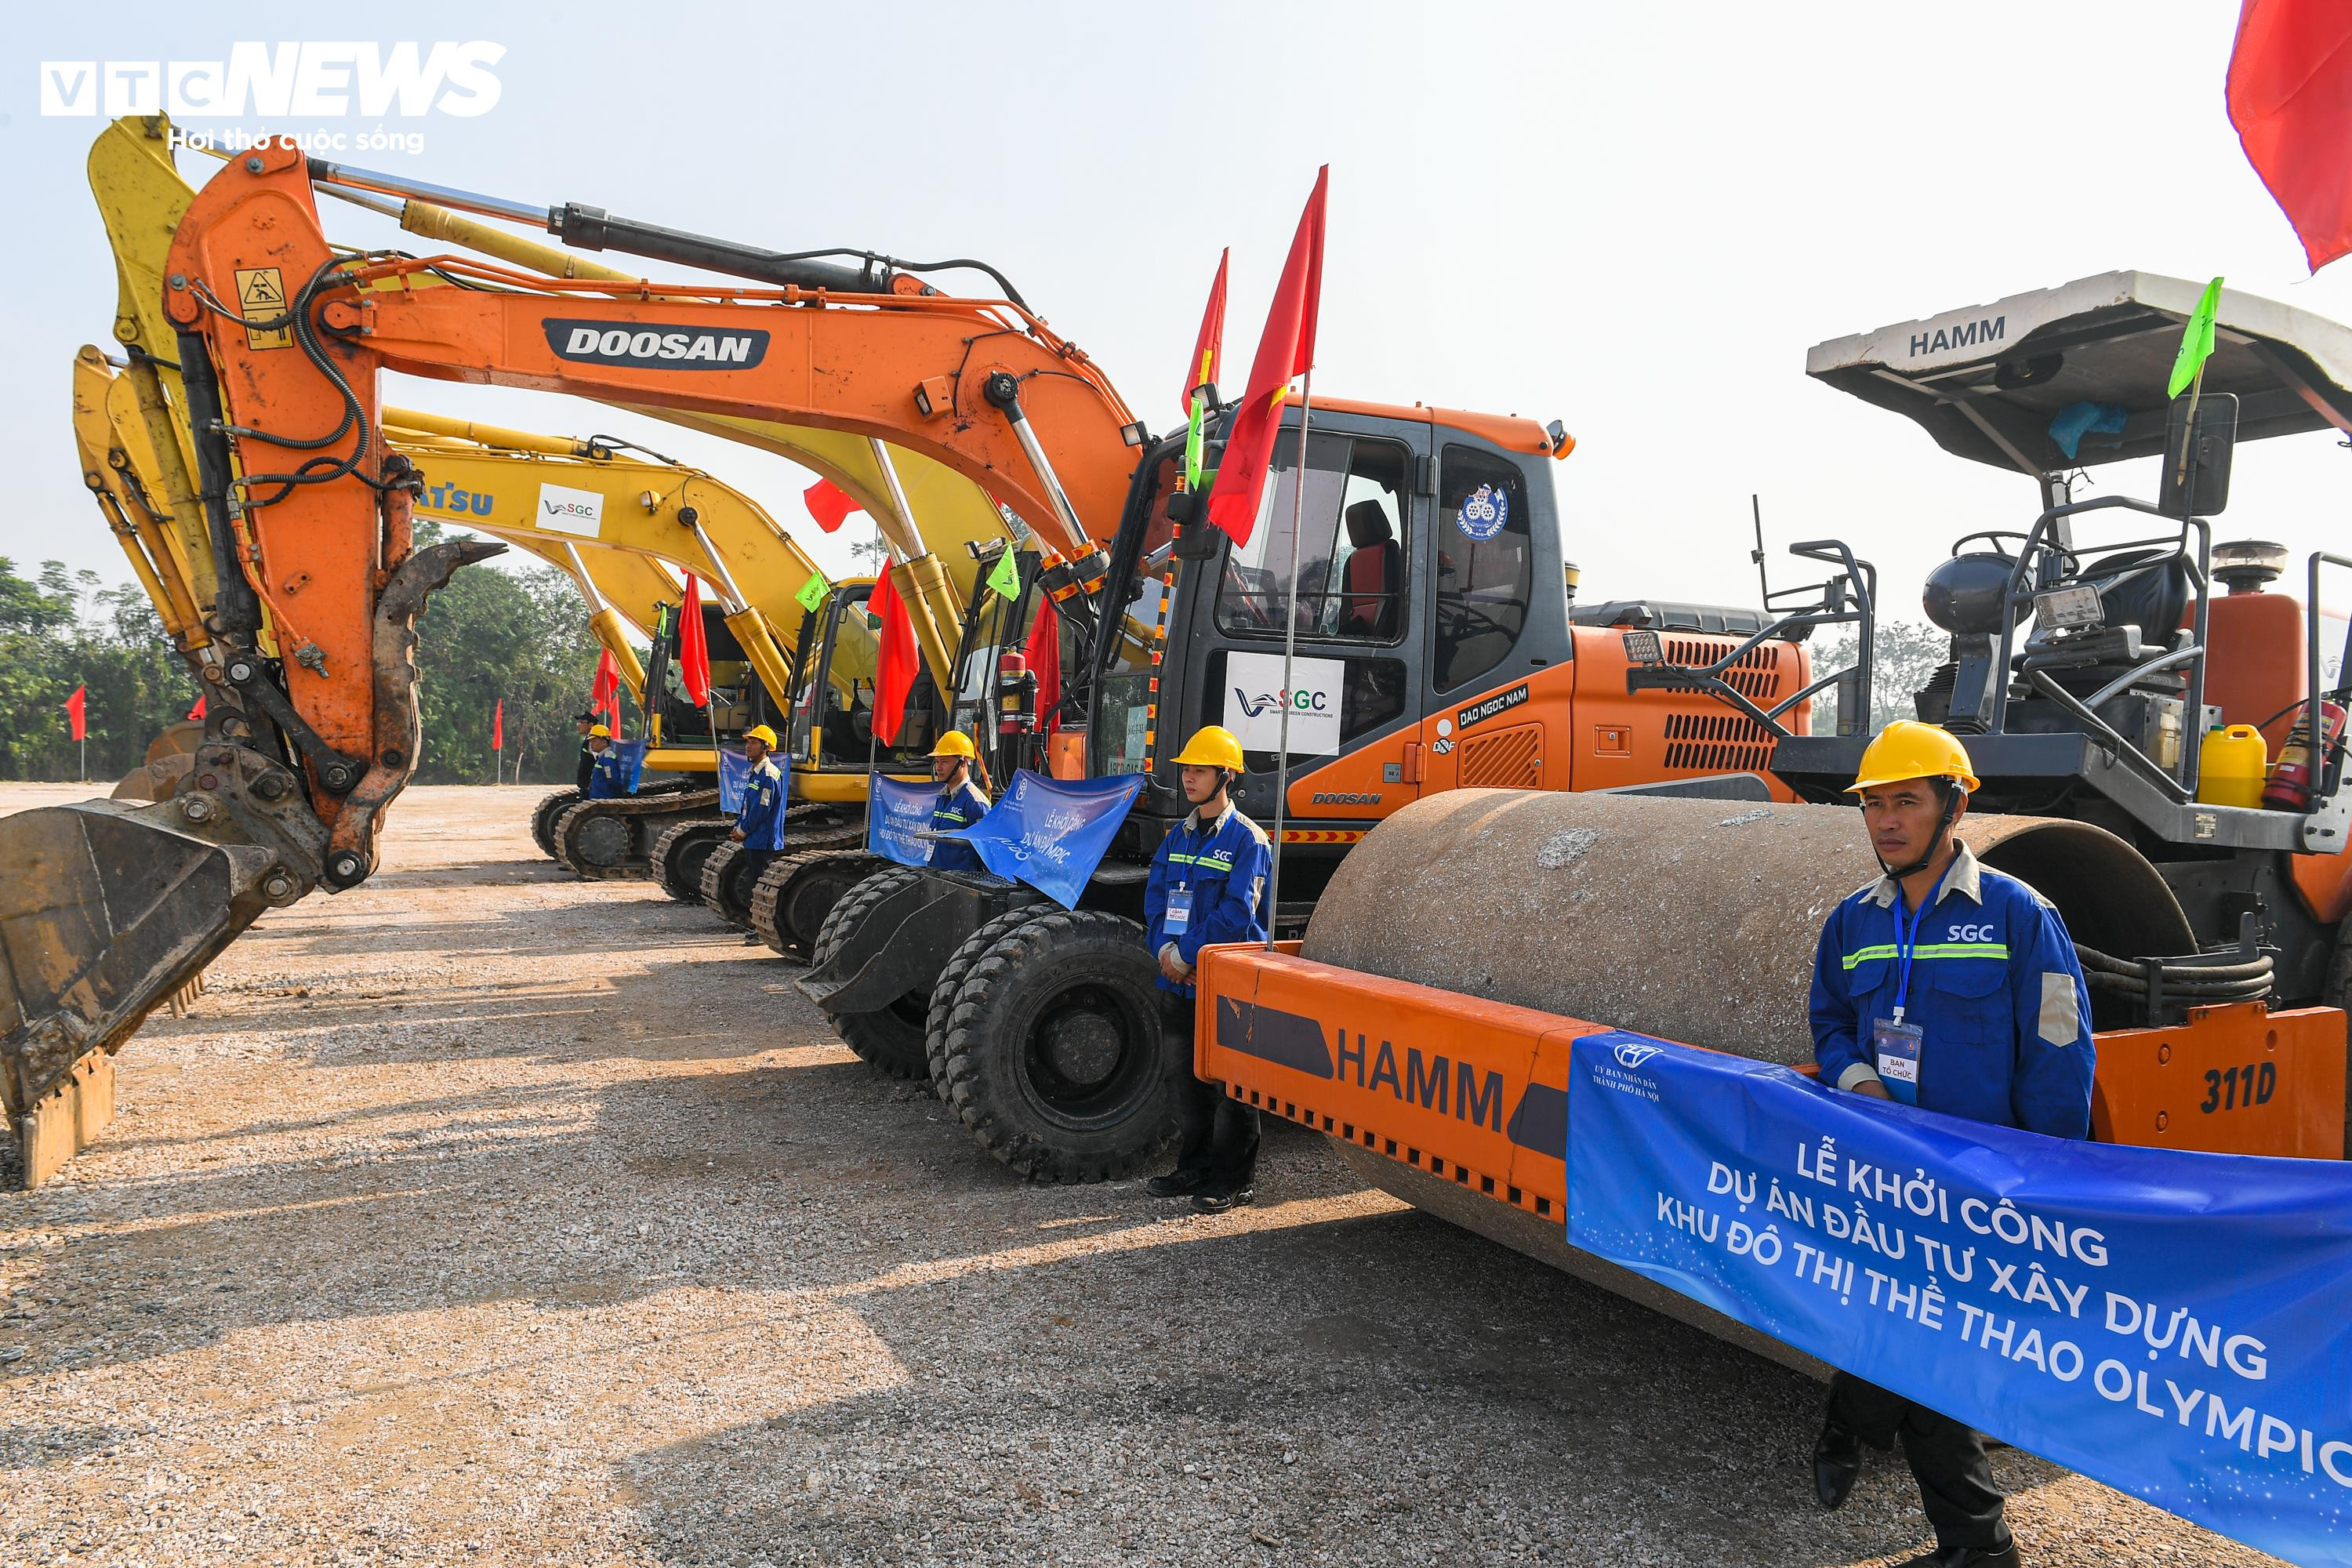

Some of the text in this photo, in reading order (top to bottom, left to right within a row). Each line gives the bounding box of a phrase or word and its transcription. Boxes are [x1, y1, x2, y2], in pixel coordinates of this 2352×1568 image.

[565, 328, 752, 362] DOOSAN
[1910, 316, 2005, 358] HAMM
[567, 503, 593, 516] SGC
[1460, 688, 1526, 726] DAO NGOC NAM
[1311, 792, 1382, 804] DOOSAN
[1947, 924, 1994, 942] SGC
[1338, 1028, 1504, 1134] HAMM
[1606, 1068, 1622, 1079] BAN
[1889, 1059, 1905, 1068] BAN
[1893, 1069, 1912, 1080] CHỨC
[2200, 1062, 2277, 1114] 311D
[1796, 1135, 2108, 1266] LỄ KHỞI CÔNG
[1707, 1161, 2267, 1380] DỰ ÁN ĐẦU TƯ XÂY DỰNG
[1657, 1192, 2352, 1489] KHU ĐÔ THỊ THỂ THAO OLYMPIC
